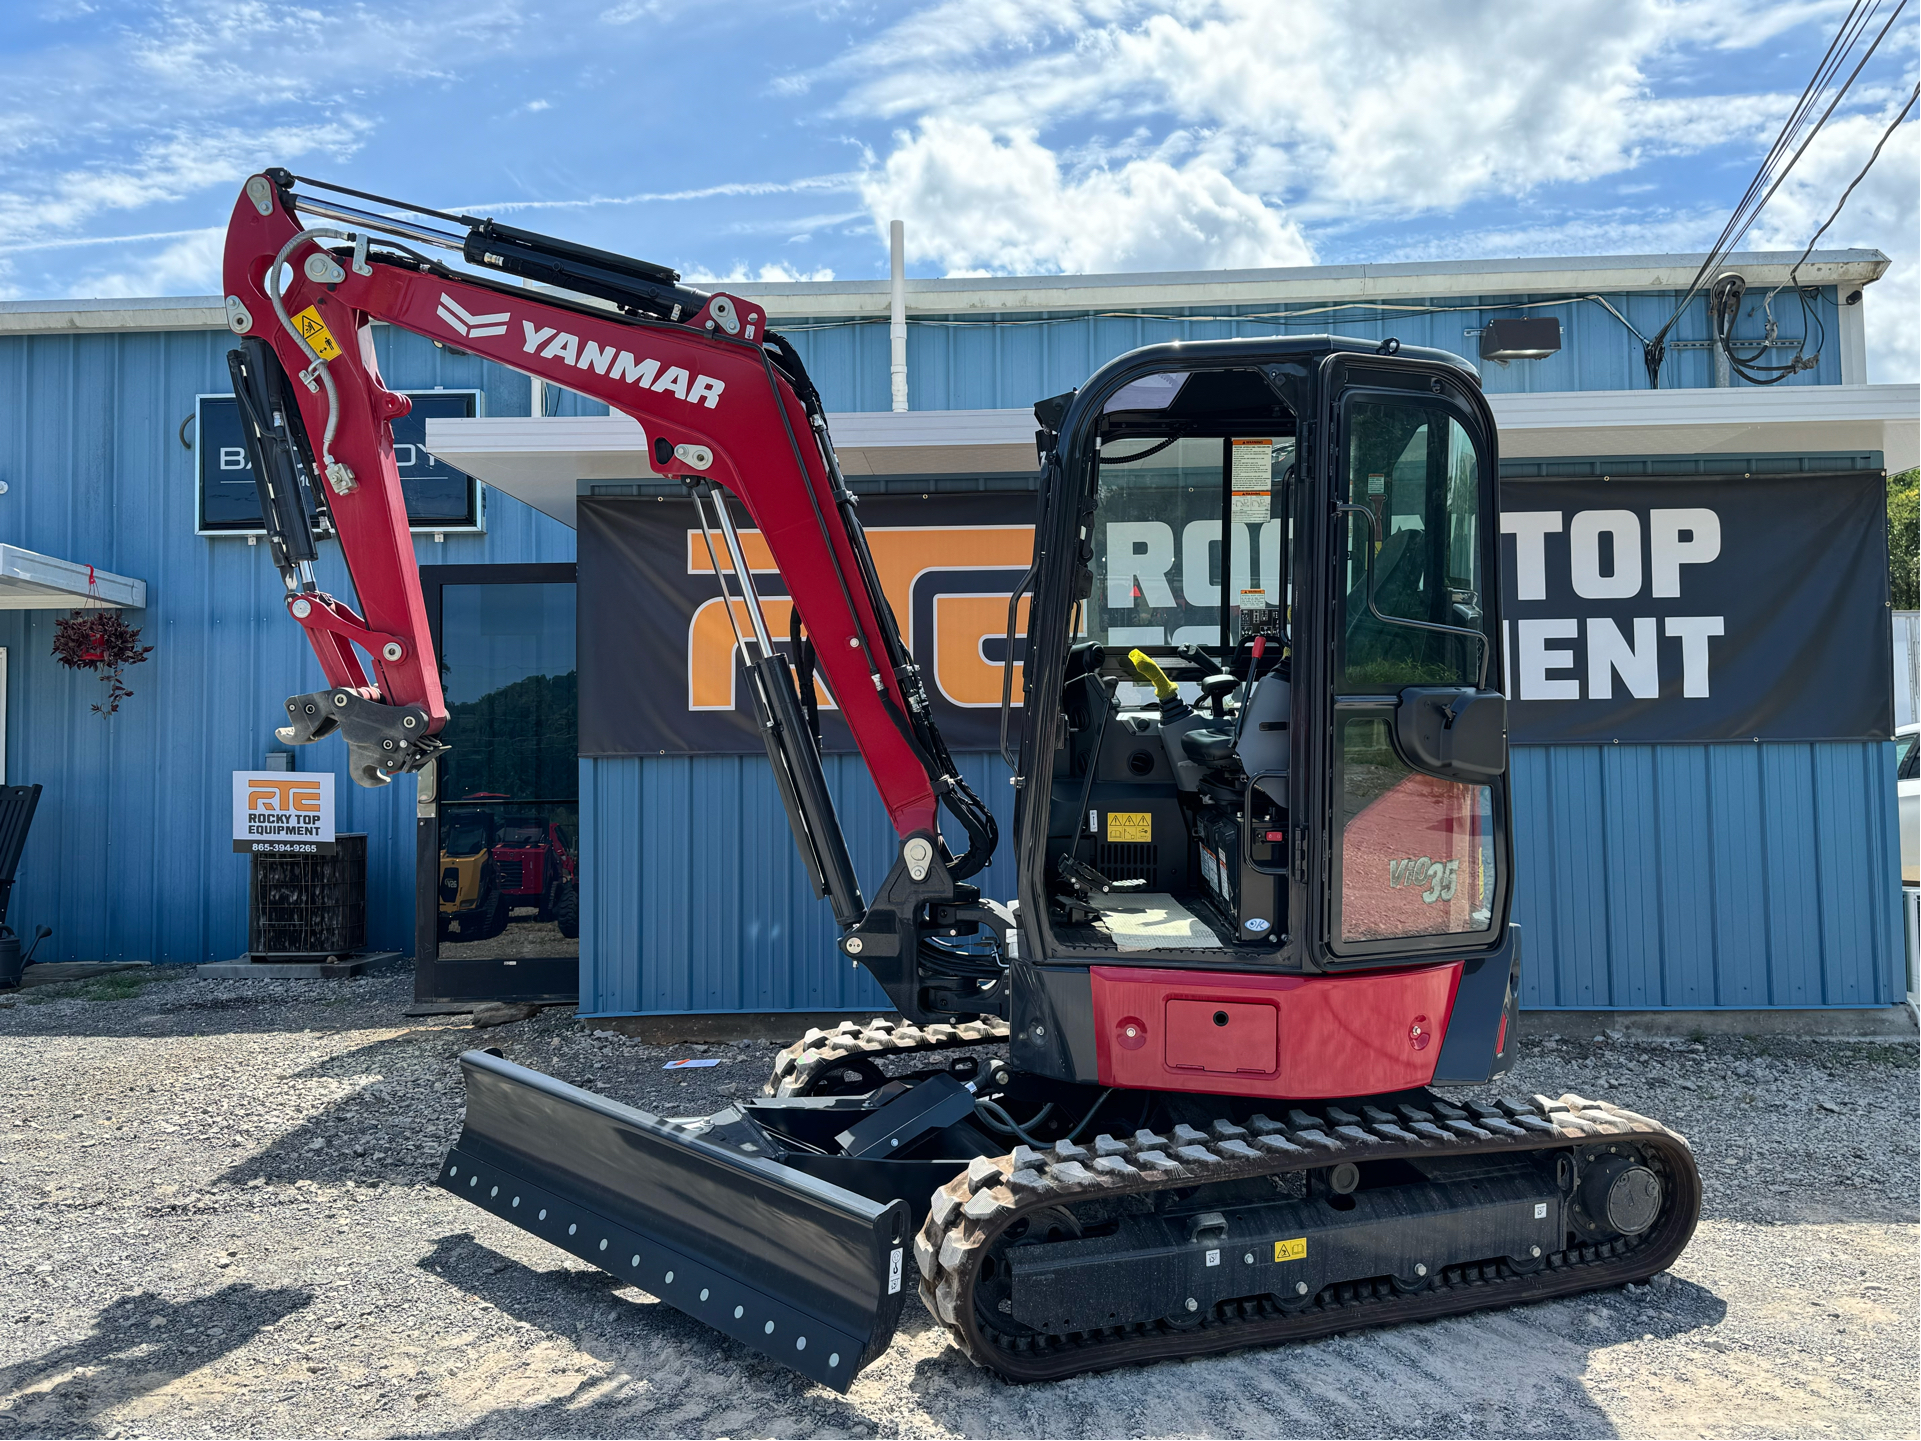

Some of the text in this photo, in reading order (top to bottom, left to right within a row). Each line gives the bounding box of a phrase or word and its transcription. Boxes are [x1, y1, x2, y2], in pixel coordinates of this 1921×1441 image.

[522, 320, 725, 409] YANMAR
[1501, 508, 1721, 600] TOP
[248, 779, 320, 812] RTE
[248, 813, 320, 825] ROCKY TOP
[248, 825, 320, 836] EQUIPMENT
[252, 843, 317, 852] 865-394-9265
